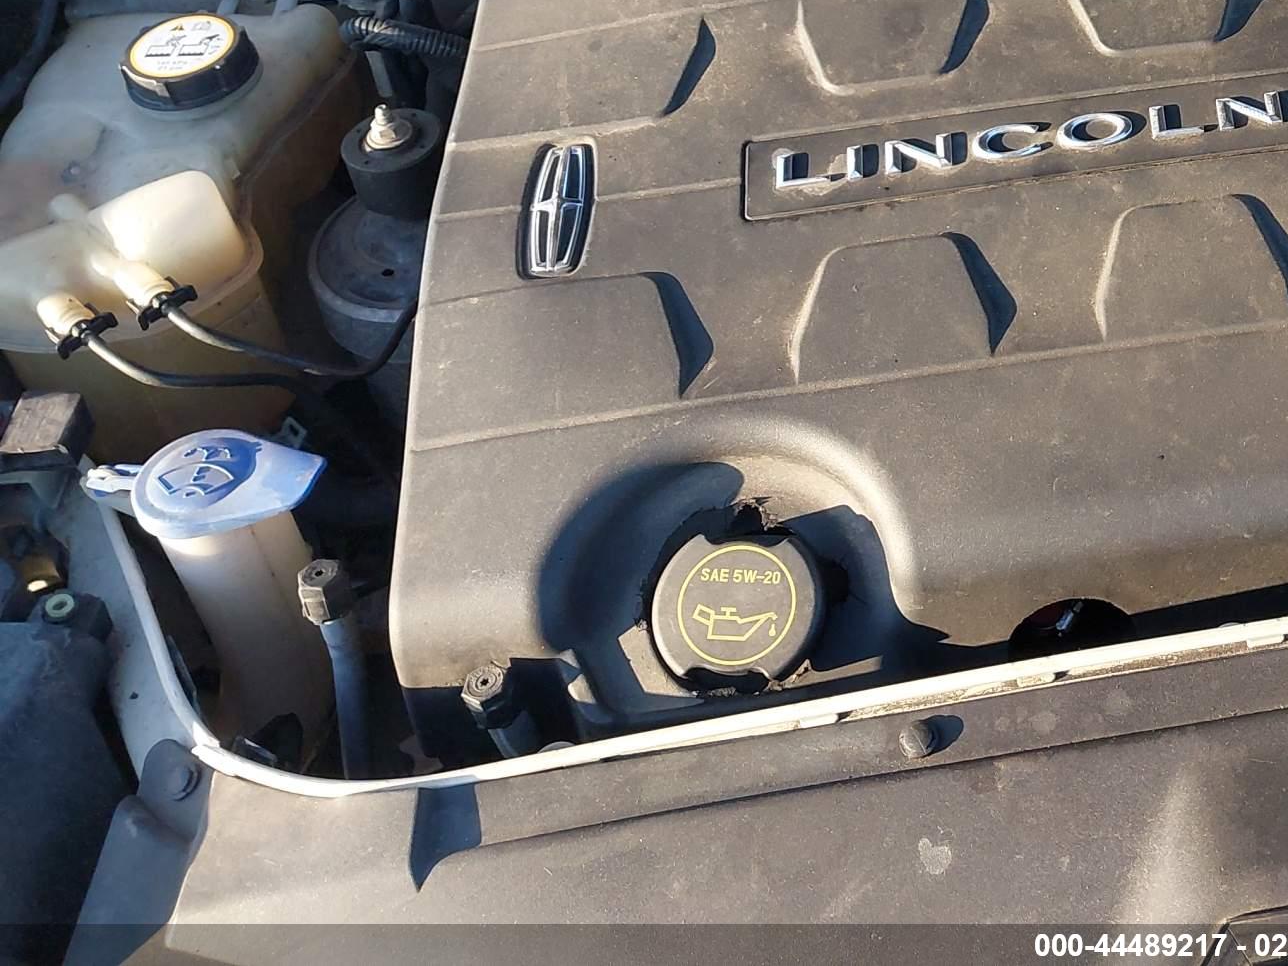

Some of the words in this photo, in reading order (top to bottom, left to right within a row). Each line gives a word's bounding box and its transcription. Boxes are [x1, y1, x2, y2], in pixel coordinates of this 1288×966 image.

[775, 89, 1285, 190] LINCOLN
[701, 568, 729, 582] SAE
[732, 569, 781, 584] 5W-20
